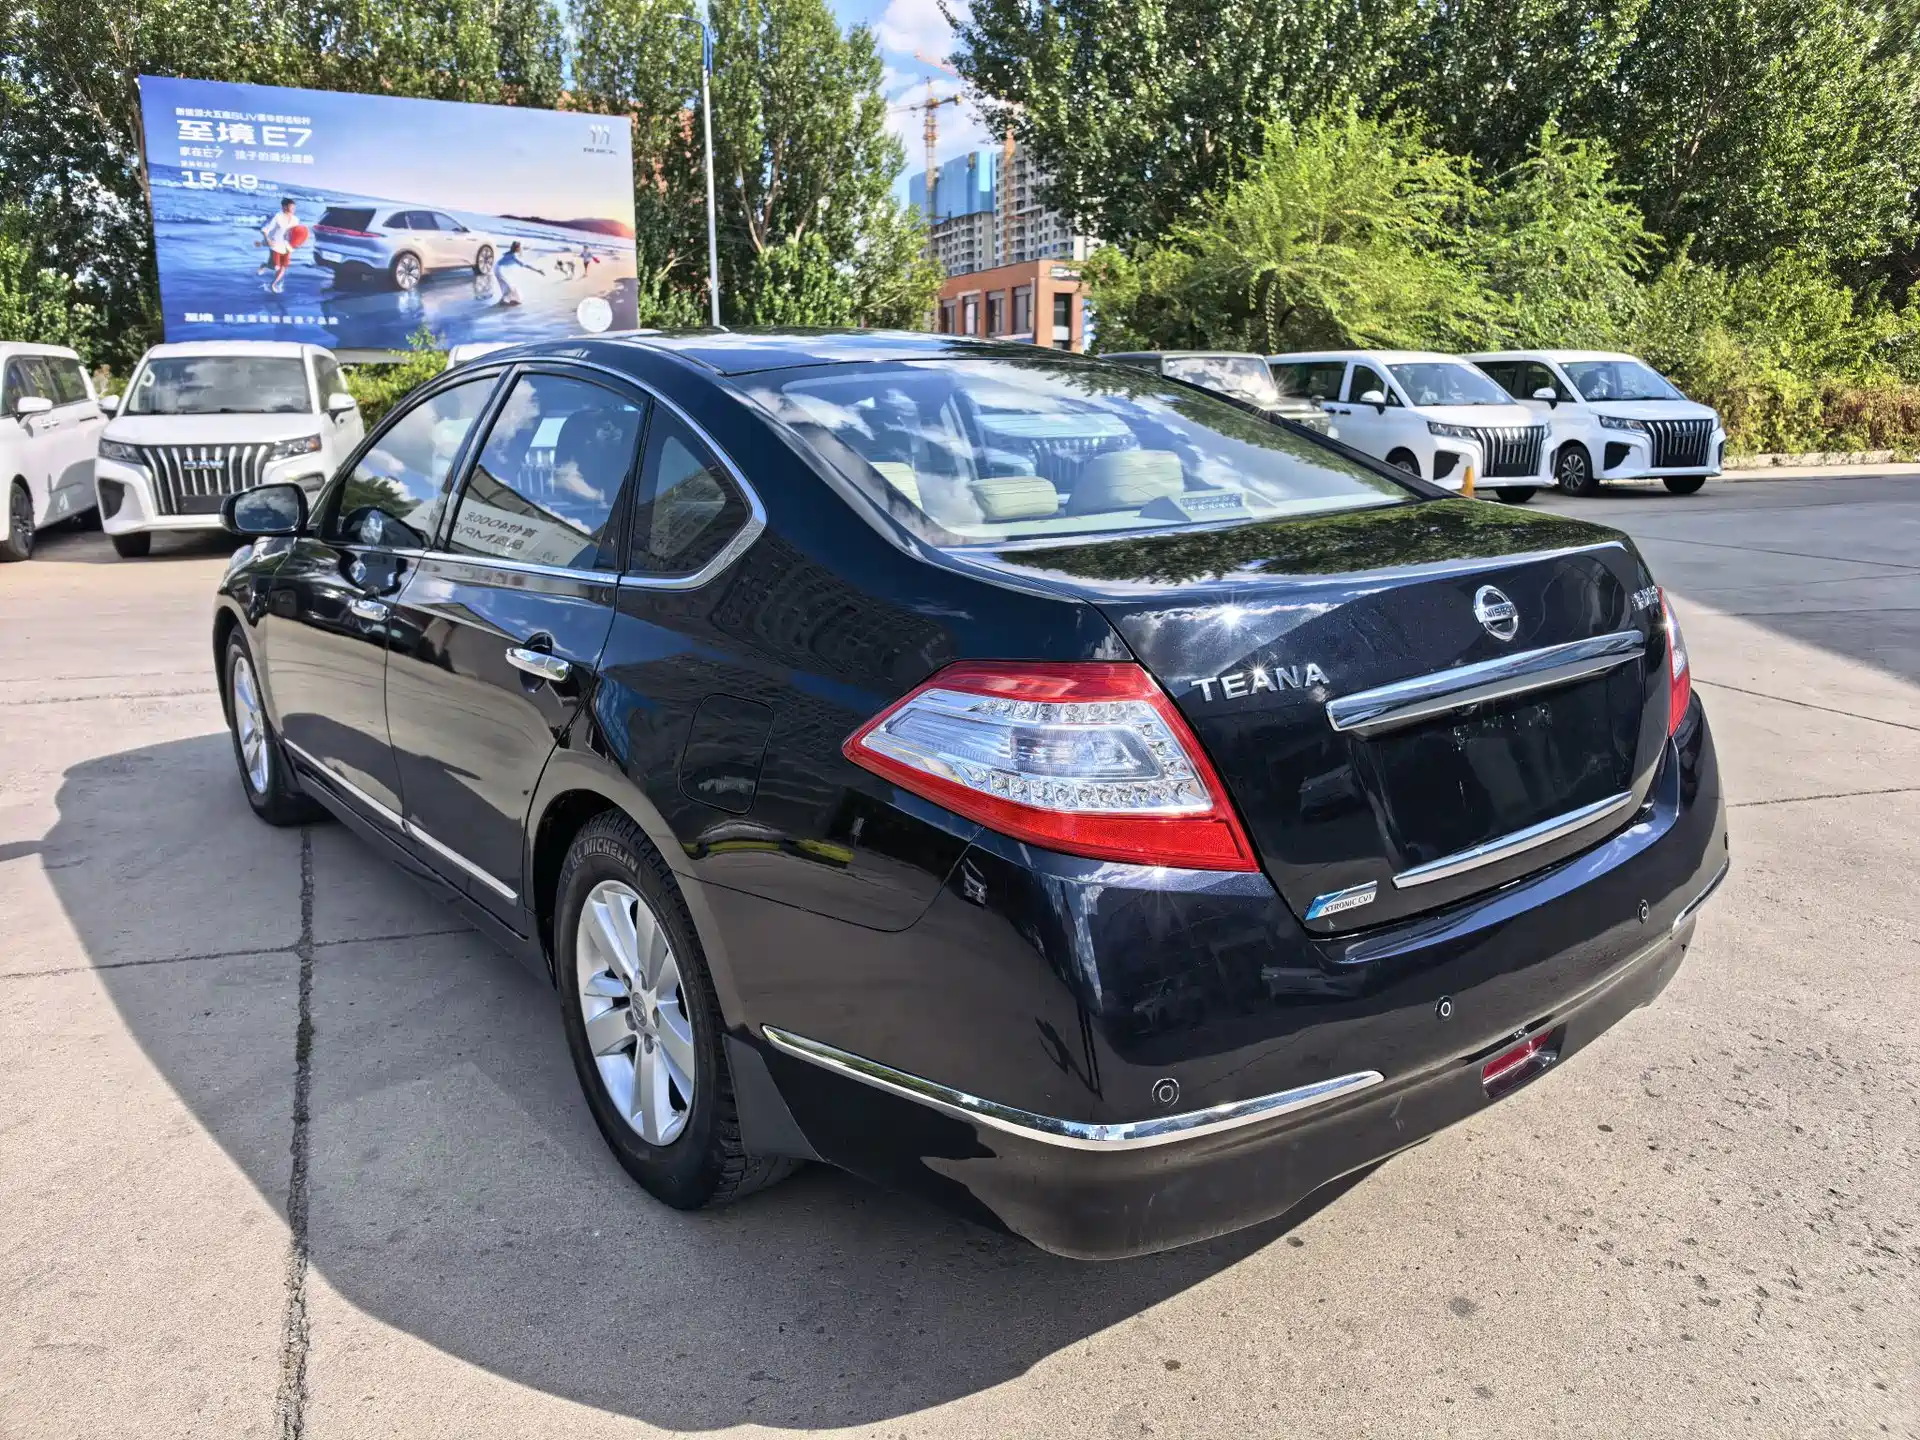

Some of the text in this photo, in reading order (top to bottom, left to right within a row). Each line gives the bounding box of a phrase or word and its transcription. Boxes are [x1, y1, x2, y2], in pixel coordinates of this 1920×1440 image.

[176, 119, 313, 148] 至境 E7
[181, 171, 258, 190] 15.49
[1190, 662, 1330, 702] TEANA
[584, 838, 639, 873] MICHELIN
[1325, 898, 1358, 913] XTRONIC
